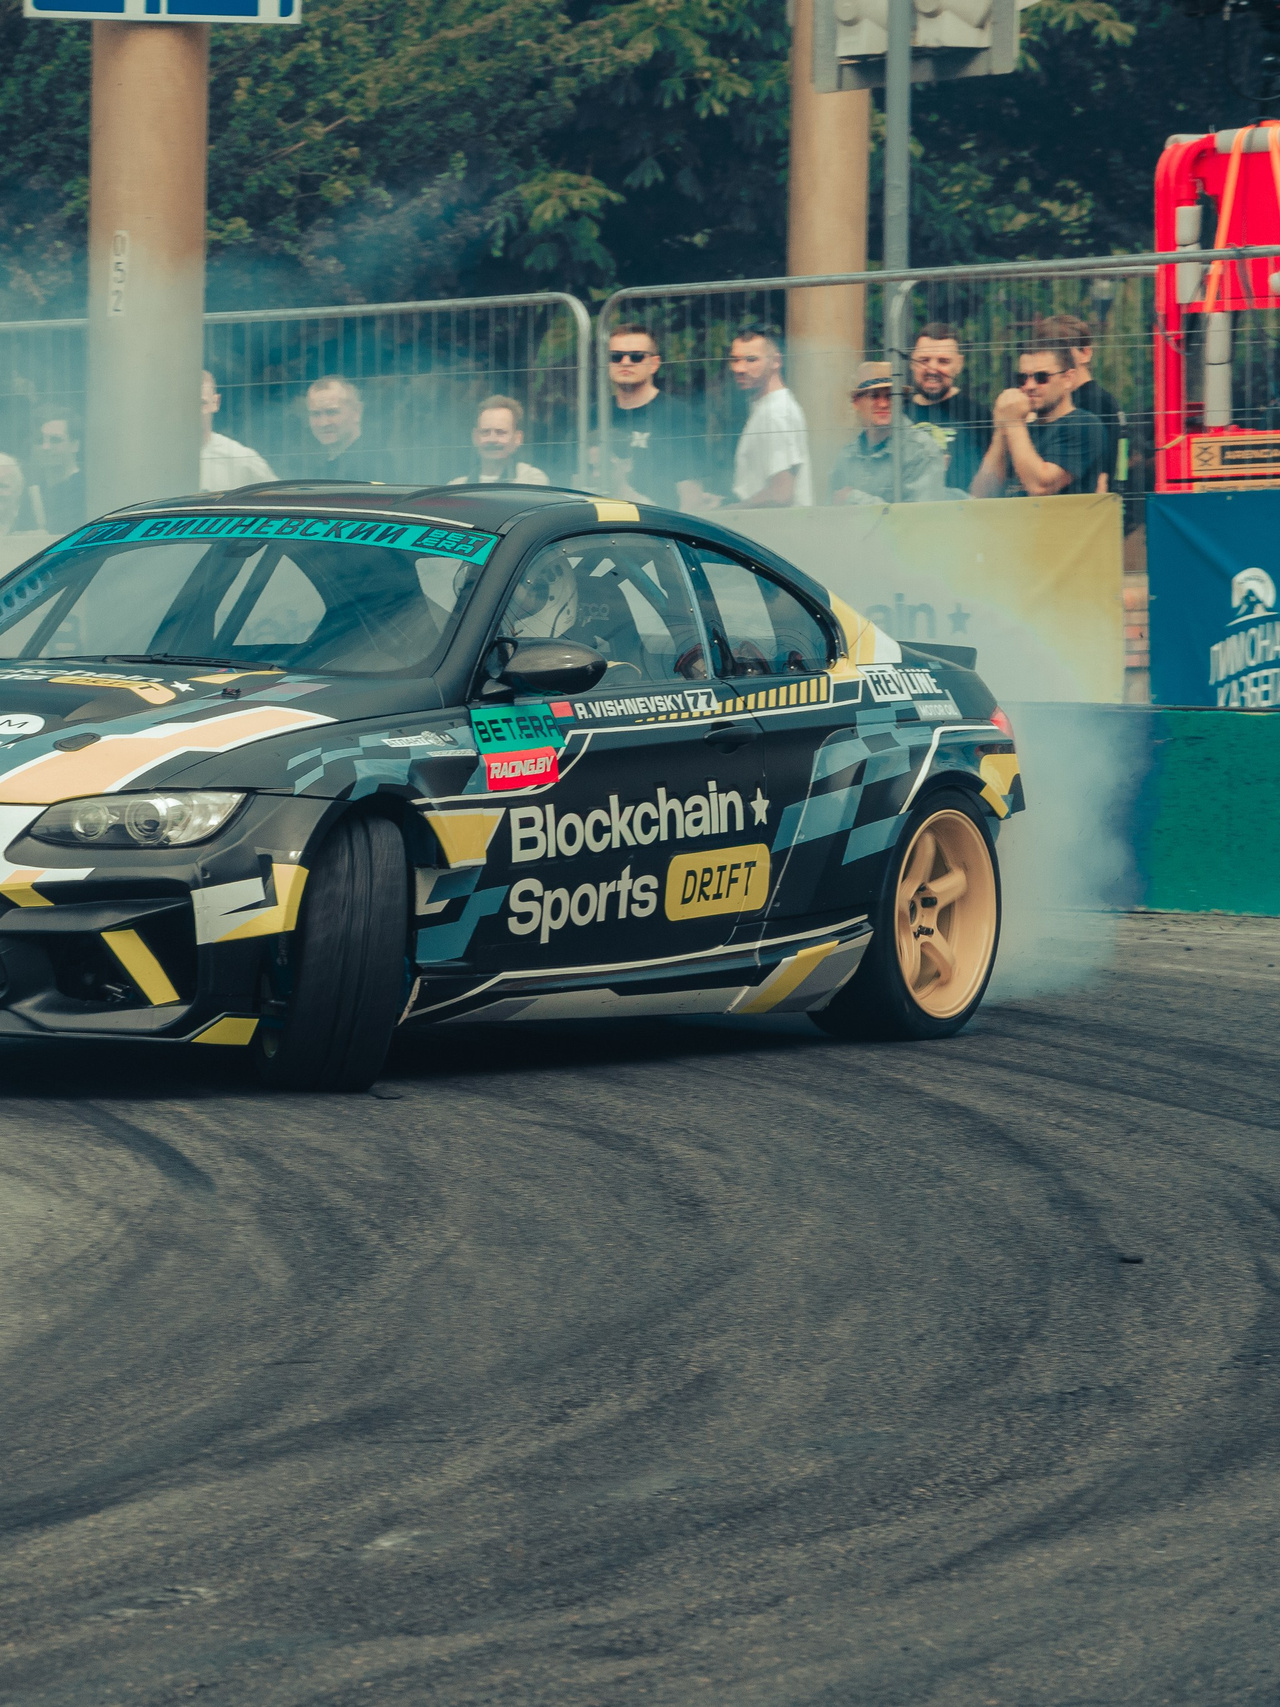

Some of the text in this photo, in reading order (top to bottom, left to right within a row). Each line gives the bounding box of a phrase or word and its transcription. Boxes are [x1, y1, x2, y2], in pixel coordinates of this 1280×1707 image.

[428, 528, 484, 545] BET
[687, 691, 715, 710] 77
[509, 780, 745, 863] Blockchain
[507, 860, 757, 944] Sports DRIFT
